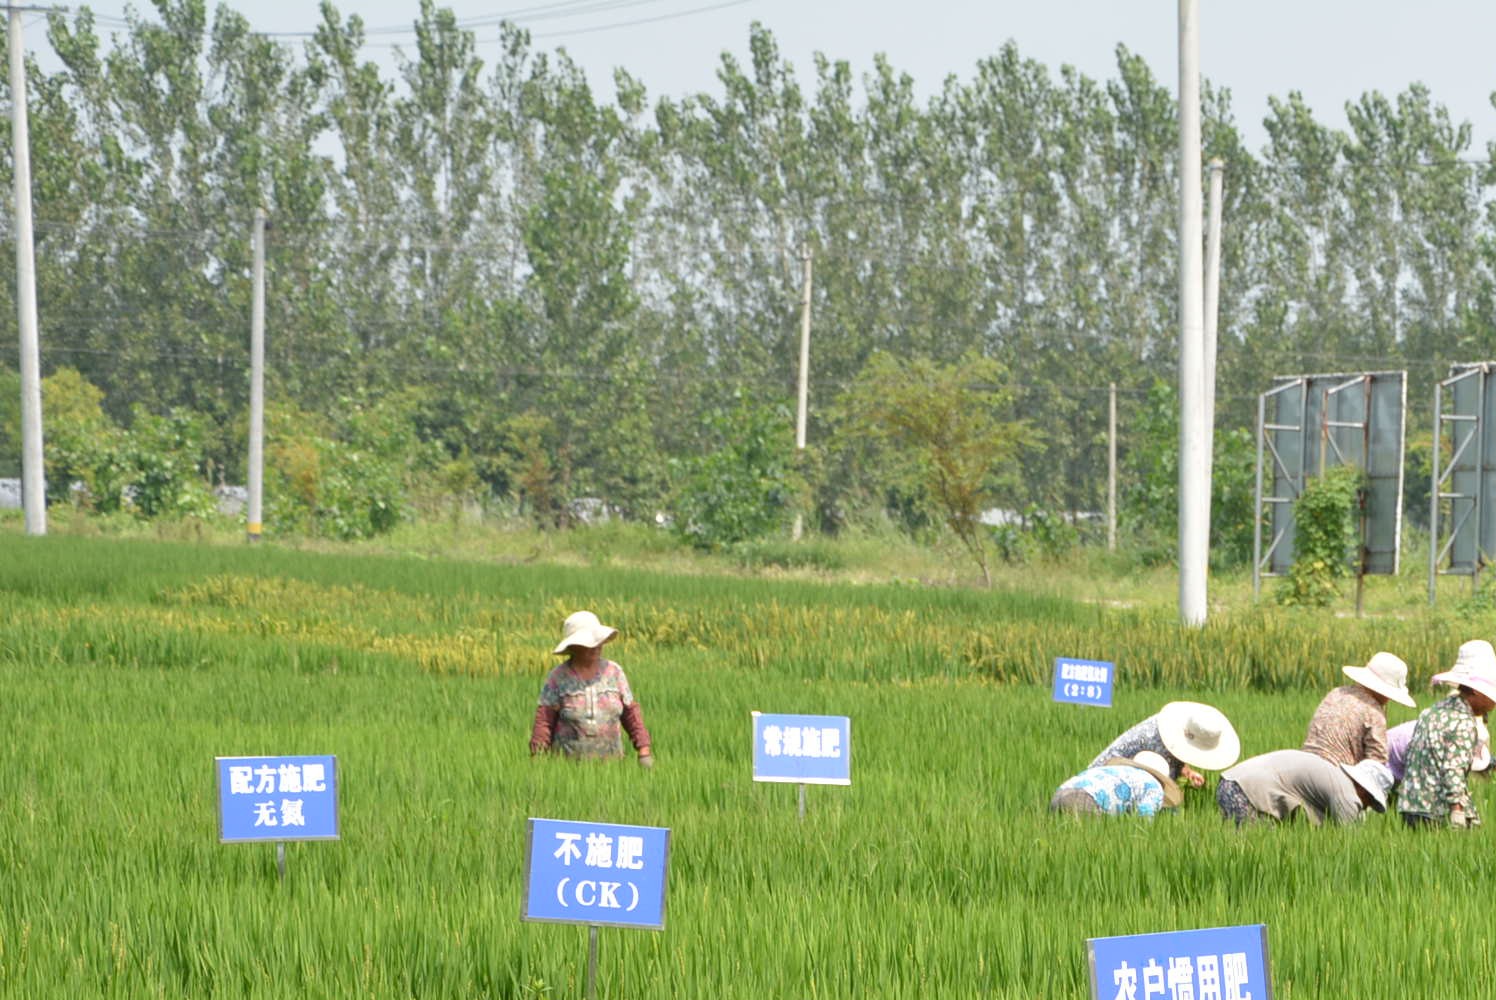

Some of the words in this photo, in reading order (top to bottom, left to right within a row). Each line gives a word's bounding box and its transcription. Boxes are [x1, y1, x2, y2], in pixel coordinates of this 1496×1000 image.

[229, 763, 327, 795] 配方施肥
[253, 798, 306, 827] 无氮
[553, 831, 644, 870] 不施肥
[556, 877, 640, 912] (CK)
